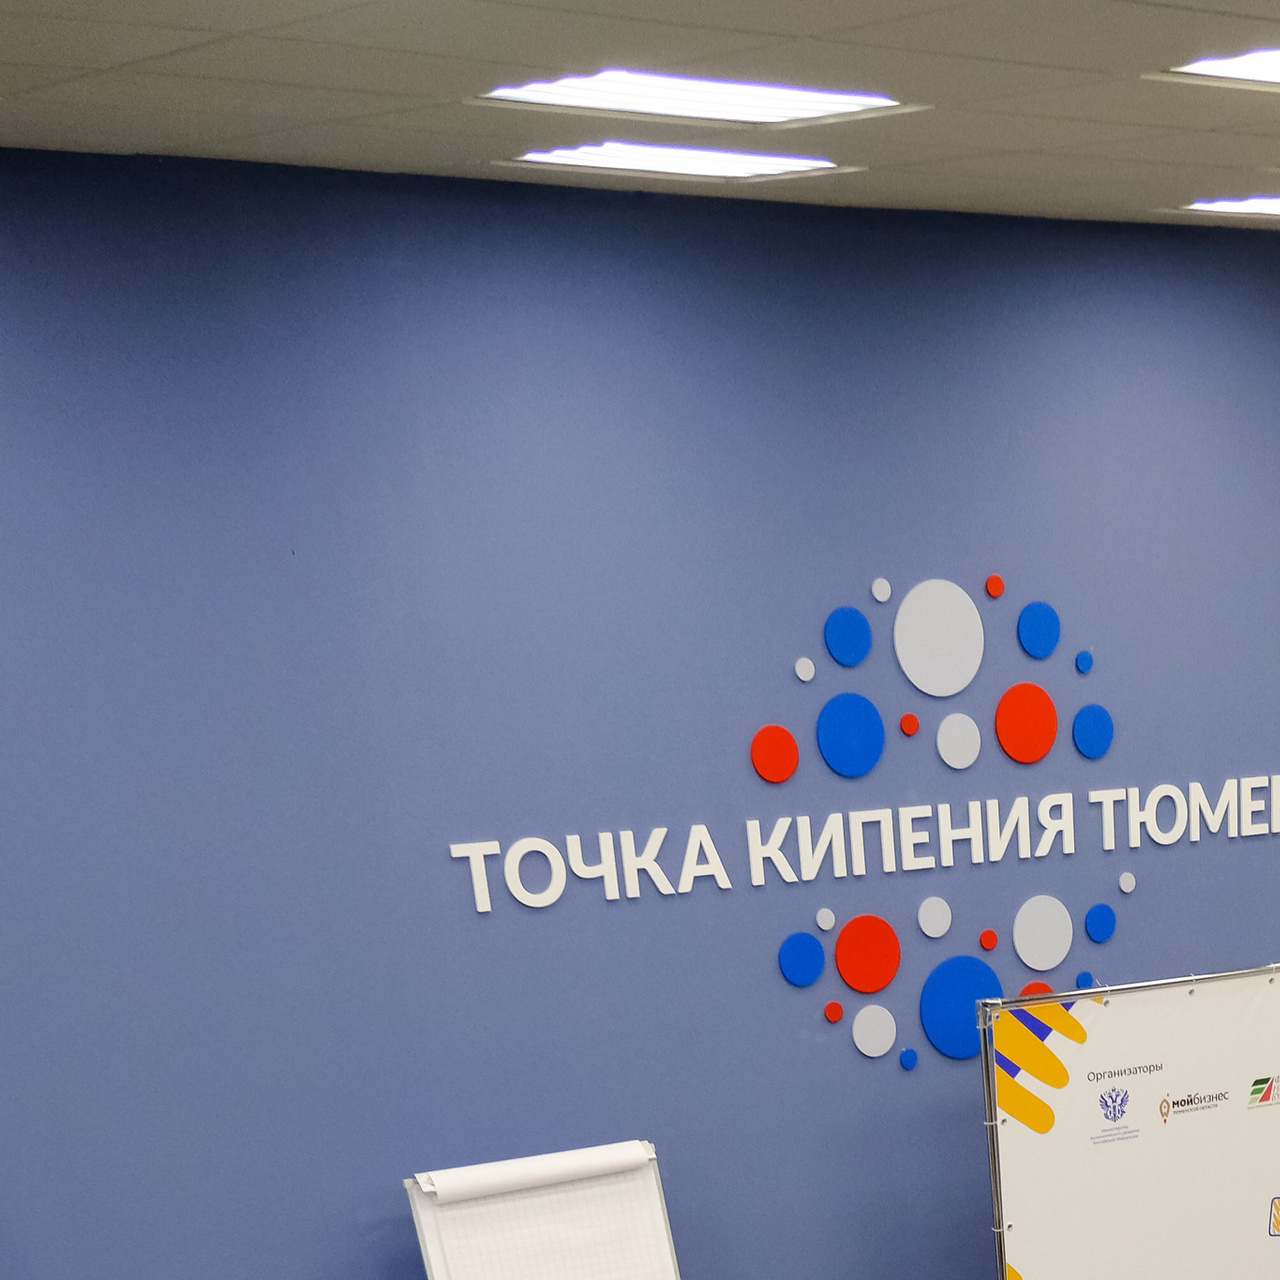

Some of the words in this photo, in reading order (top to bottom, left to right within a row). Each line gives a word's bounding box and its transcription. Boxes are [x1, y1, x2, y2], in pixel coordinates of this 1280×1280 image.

[450, 824, 732, 914] ТОЧКА
[745, 791, 1076, 887] КИПЕНИЯ
[1087, 1062, 1164, 1083] Организаторы
